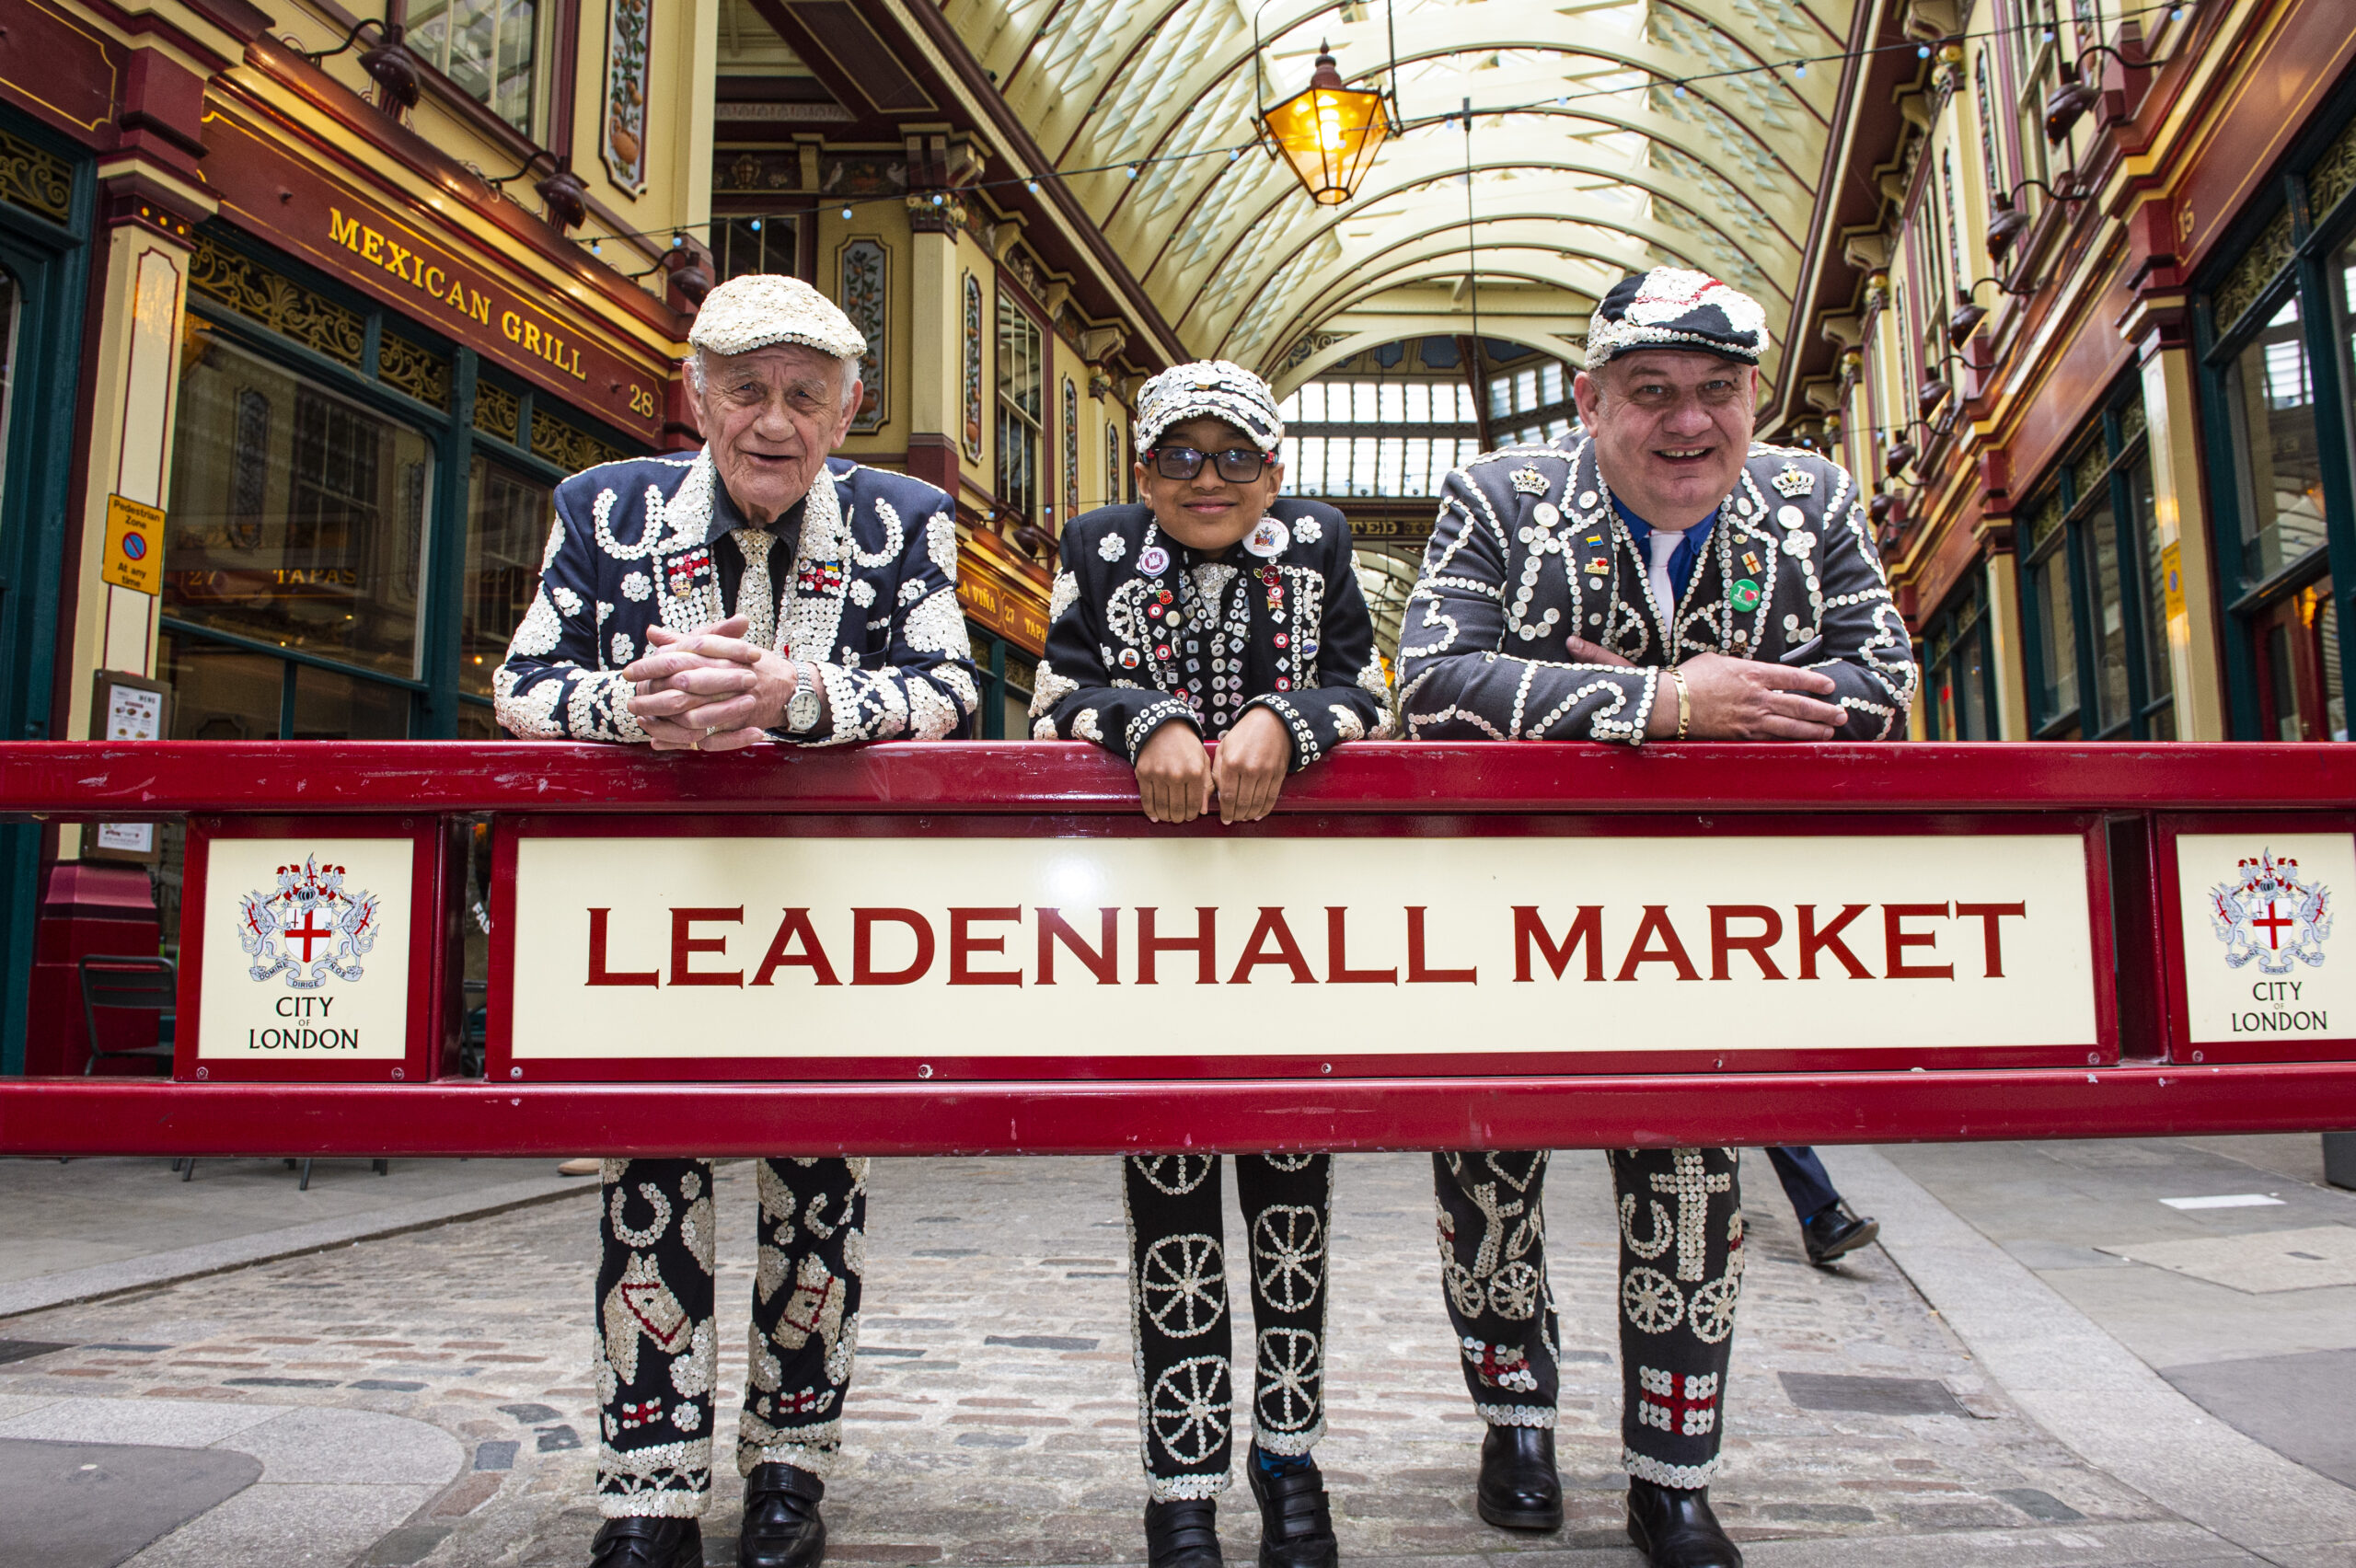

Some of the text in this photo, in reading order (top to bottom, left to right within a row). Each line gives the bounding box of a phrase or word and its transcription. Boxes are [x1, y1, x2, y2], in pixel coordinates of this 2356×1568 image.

[329, 207, 587, 381] MEXICAN GRILL
[629, 384, 655, 419] 28
[113, 500, 161, 523] Pedestrian
[125, 515, 147, 530] Zone
[118, 562, 147, 580] At any
[121, 575, 142, 589] time
[972, 585, 997, 614] VIÑA
[1004, 605, 1049, 643] 27 TAPA
[584, 899, 2027, 990] LEADENHALL MARKET
[260, 962, 347, 988] DOMINE DIRIGE NOS
[2253, 981, 2303, 1001] CITY
[276, 997, 334, 1017] CITY
[298, 1019, 311, 1027] OF
[2232, 1011, 2327, 1032] LONDON
[249, 1029, 359, 1049] LONDON
